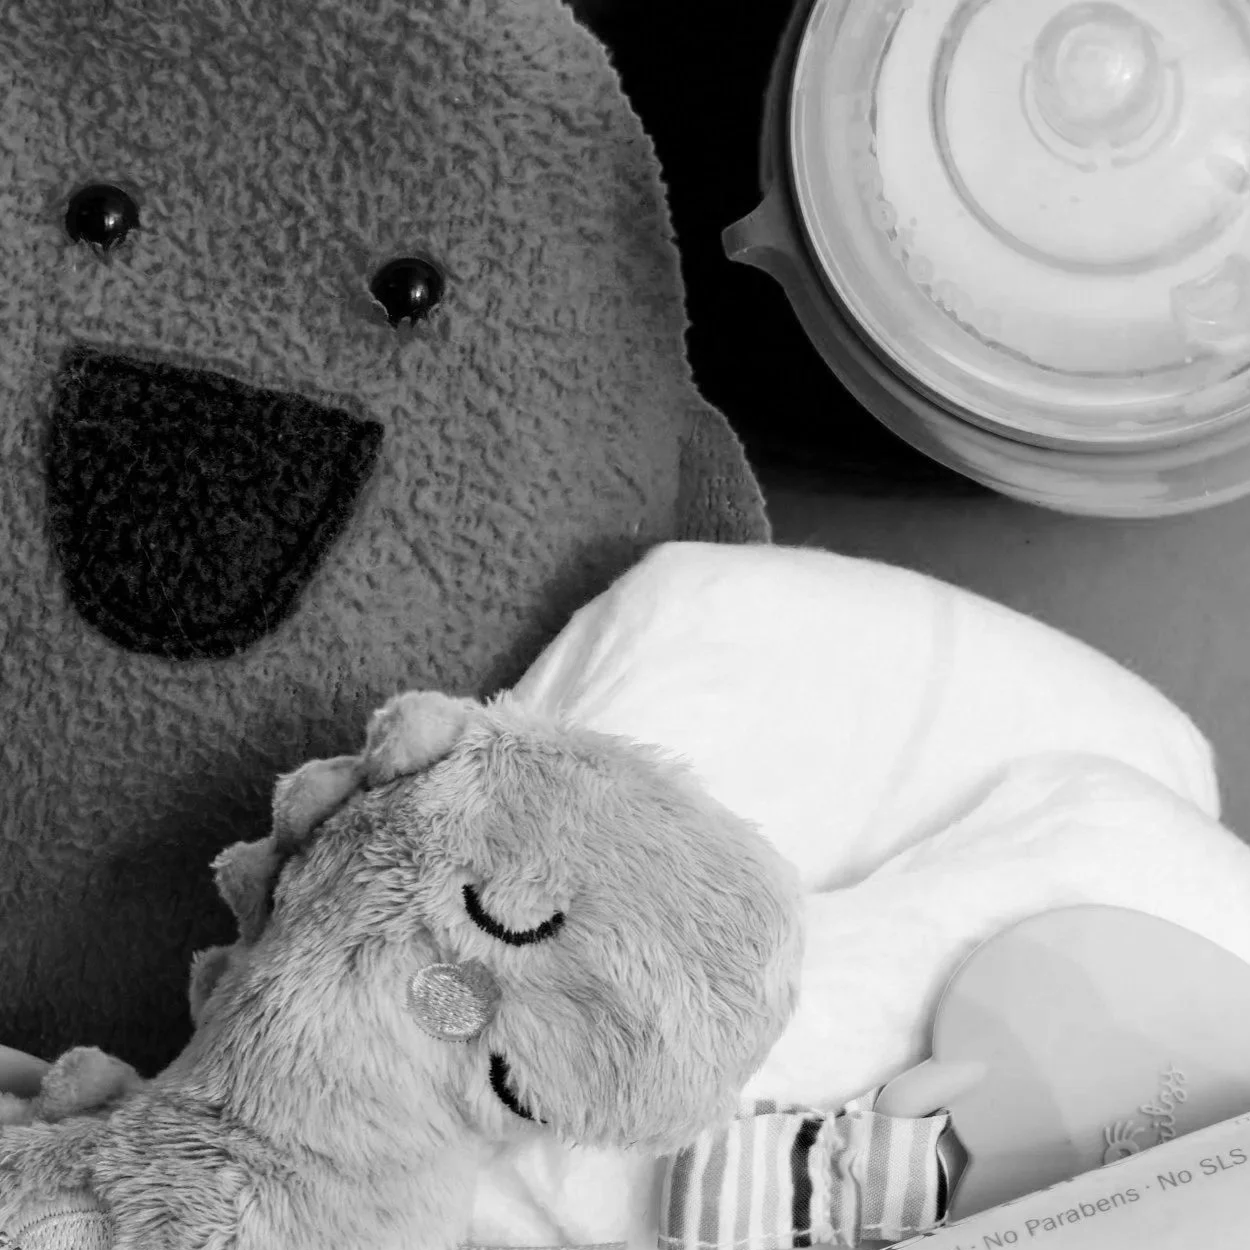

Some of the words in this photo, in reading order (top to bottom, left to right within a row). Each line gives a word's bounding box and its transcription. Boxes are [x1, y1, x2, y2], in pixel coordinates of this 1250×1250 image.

[1025, 1187, 1141, 1237] Parabens
[1157, 1169, 1193, 1191] No
[1199, 1148, 1248, 1177] SLS
